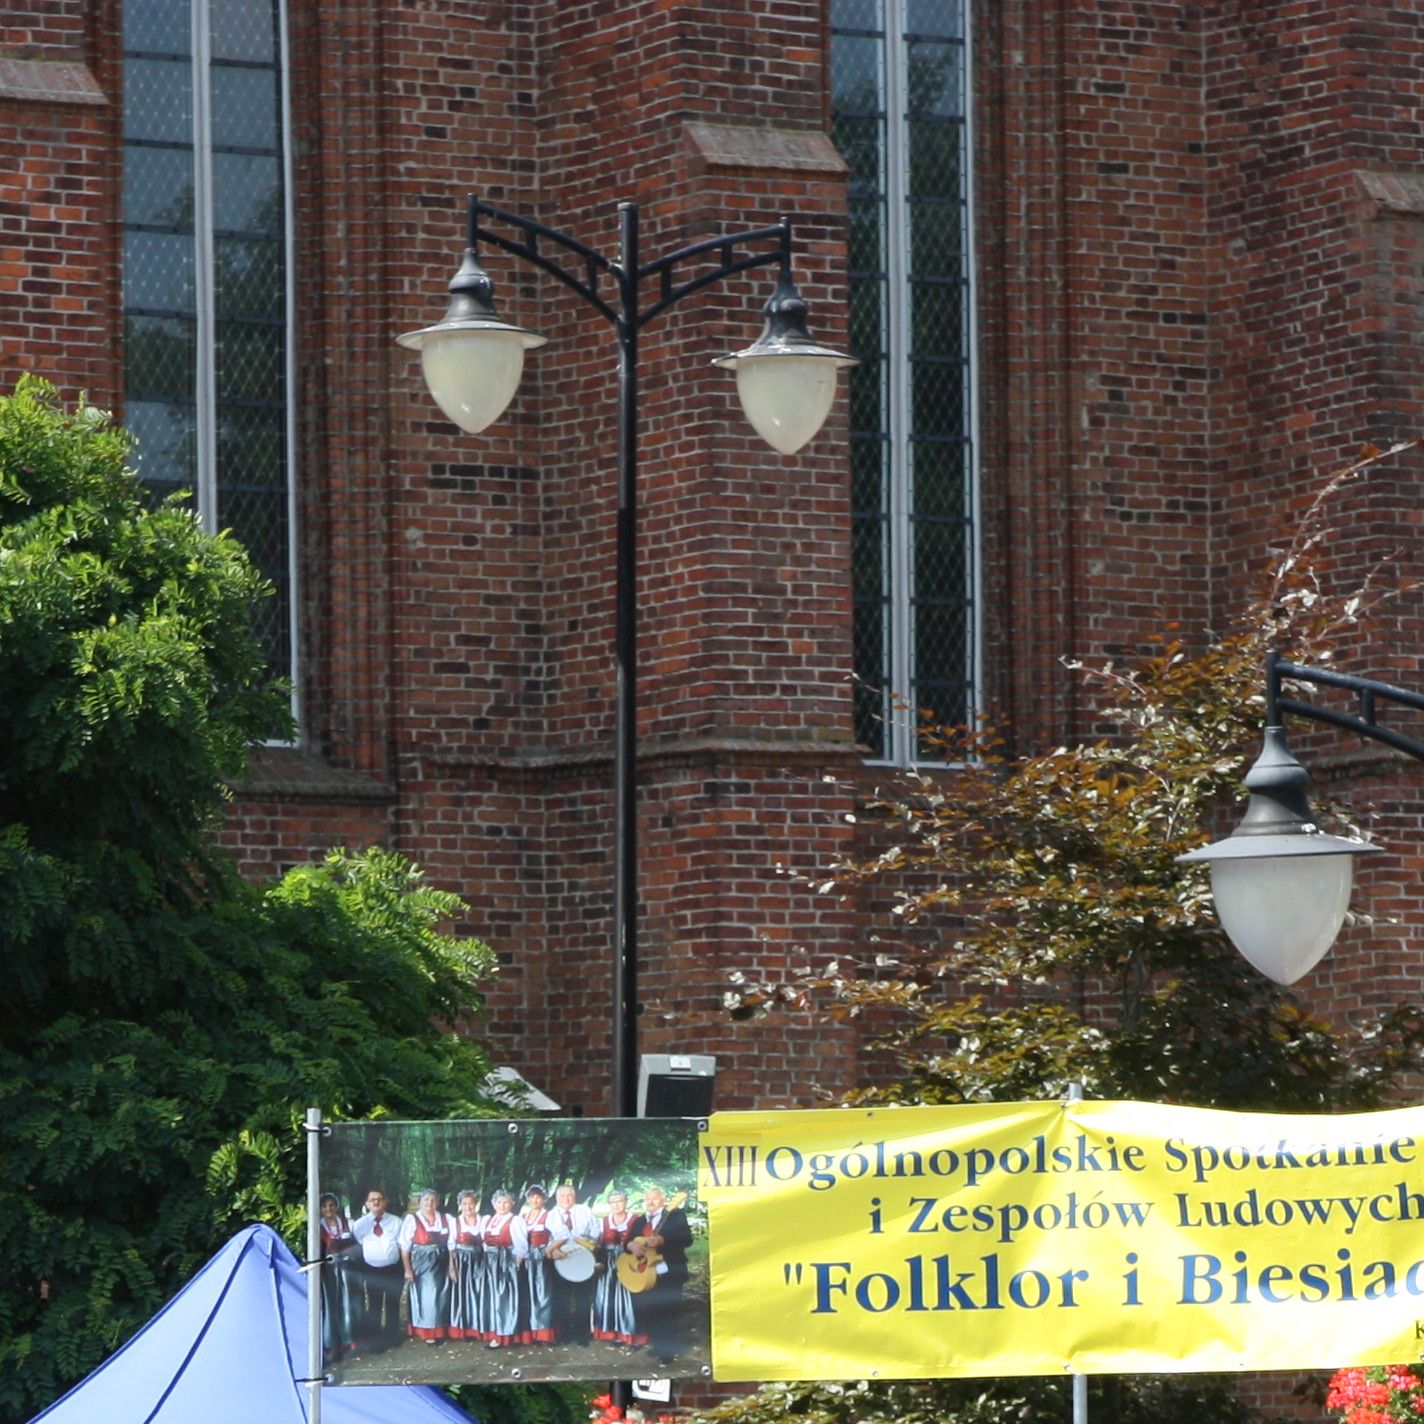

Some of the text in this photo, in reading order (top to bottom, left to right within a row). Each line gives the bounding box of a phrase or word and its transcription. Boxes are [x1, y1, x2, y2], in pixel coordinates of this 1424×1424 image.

[702, 1145, 758, 1187] XIII
[765, 1133, 1146, 1191] Ogólnopolskie
[1165, 1134, 1416, 1183] Spotkanie
[869, 1197, 884, 1234] i
[908, 1190, 1153, 1243] Zespołów
[783, 1253, 1089, 1313] "Folklor
[1121, 1252, 1143, 1305] i
